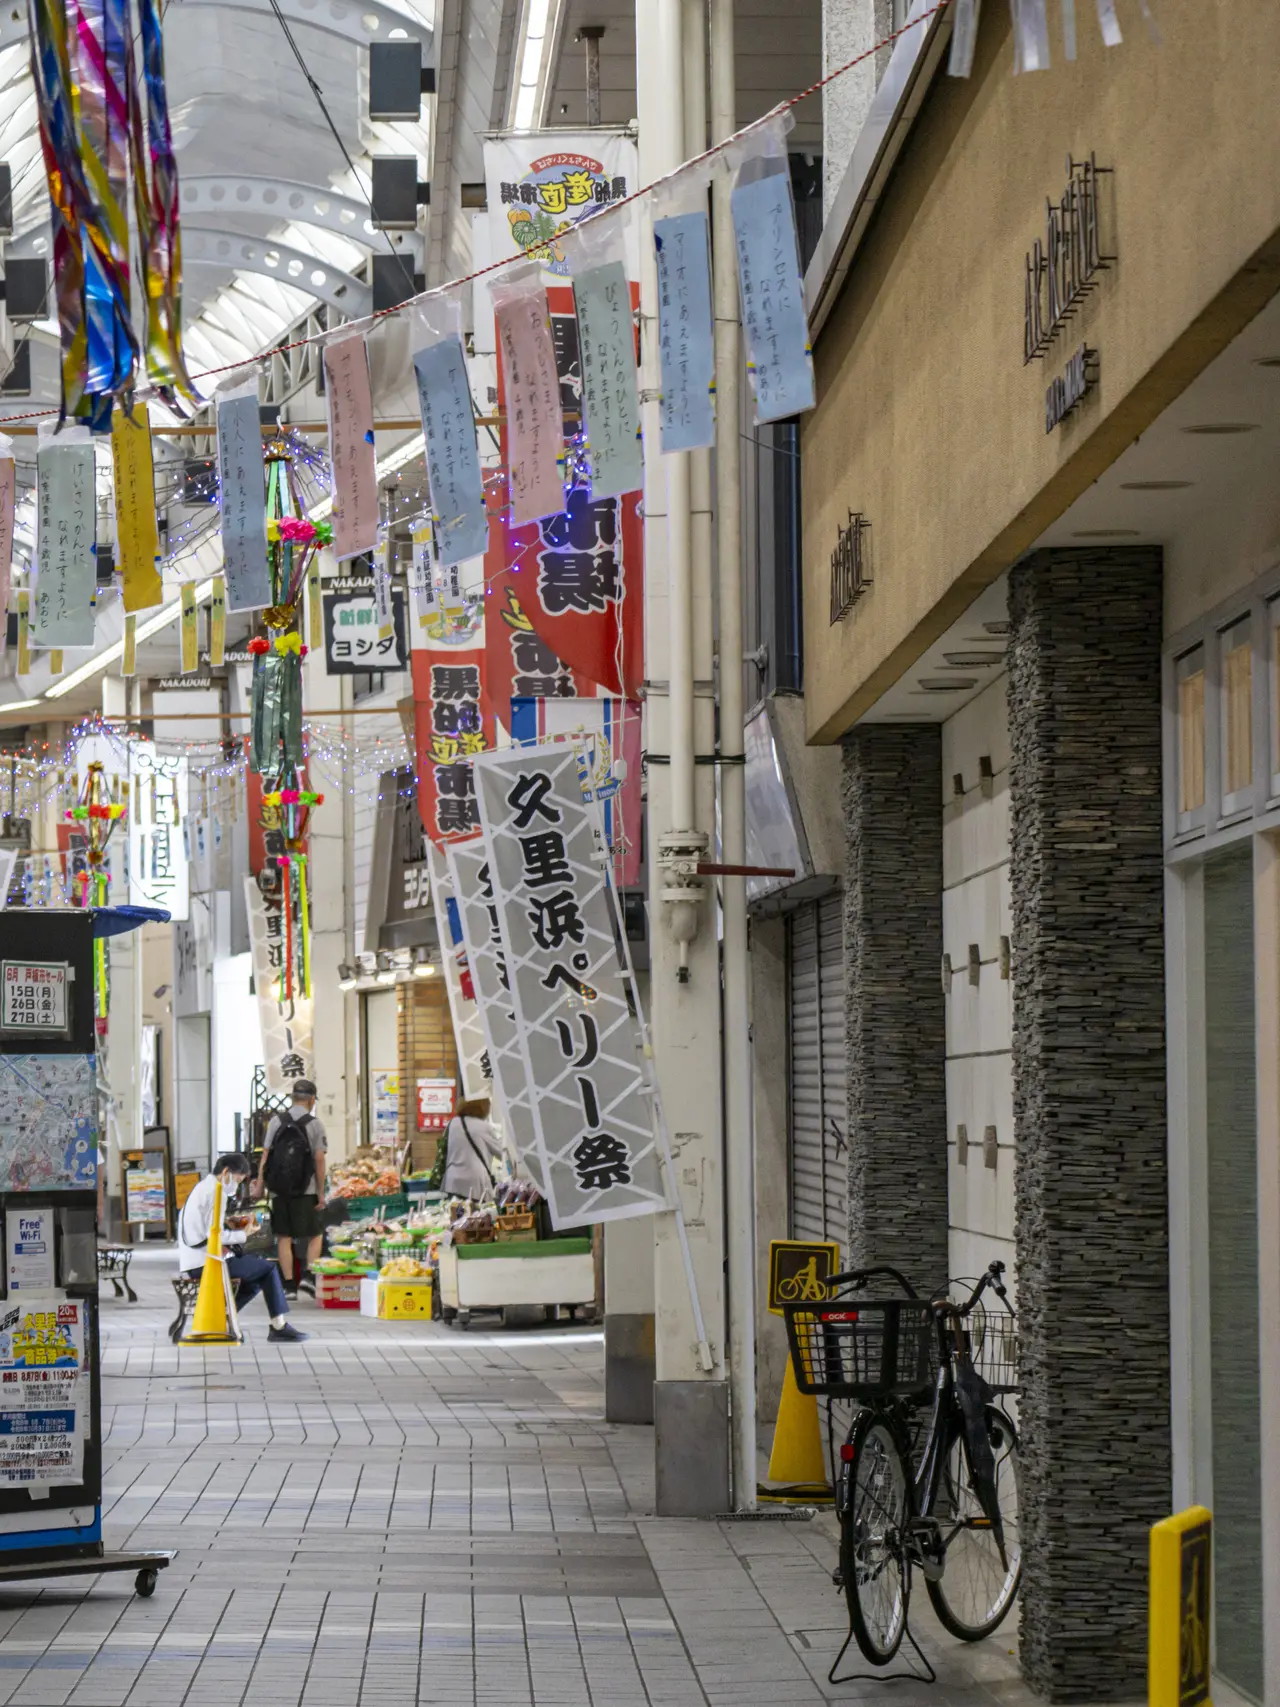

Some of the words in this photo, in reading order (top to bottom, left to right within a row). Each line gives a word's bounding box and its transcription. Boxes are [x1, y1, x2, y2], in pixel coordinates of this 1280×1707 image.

[159, 677, 211, 688] NAKADORI
[507, 771, 631, 1190] 久里浜ペリー祭
[10, 985, 56, 998] 15日(月)
[10, 998, 56, 1011] 26日(金)
[10, 1011, 56, 1024] 27日(土)
[19, 1218, 41, 1230] Free
[19, 1230, 41, 1241] Wi-Fi
